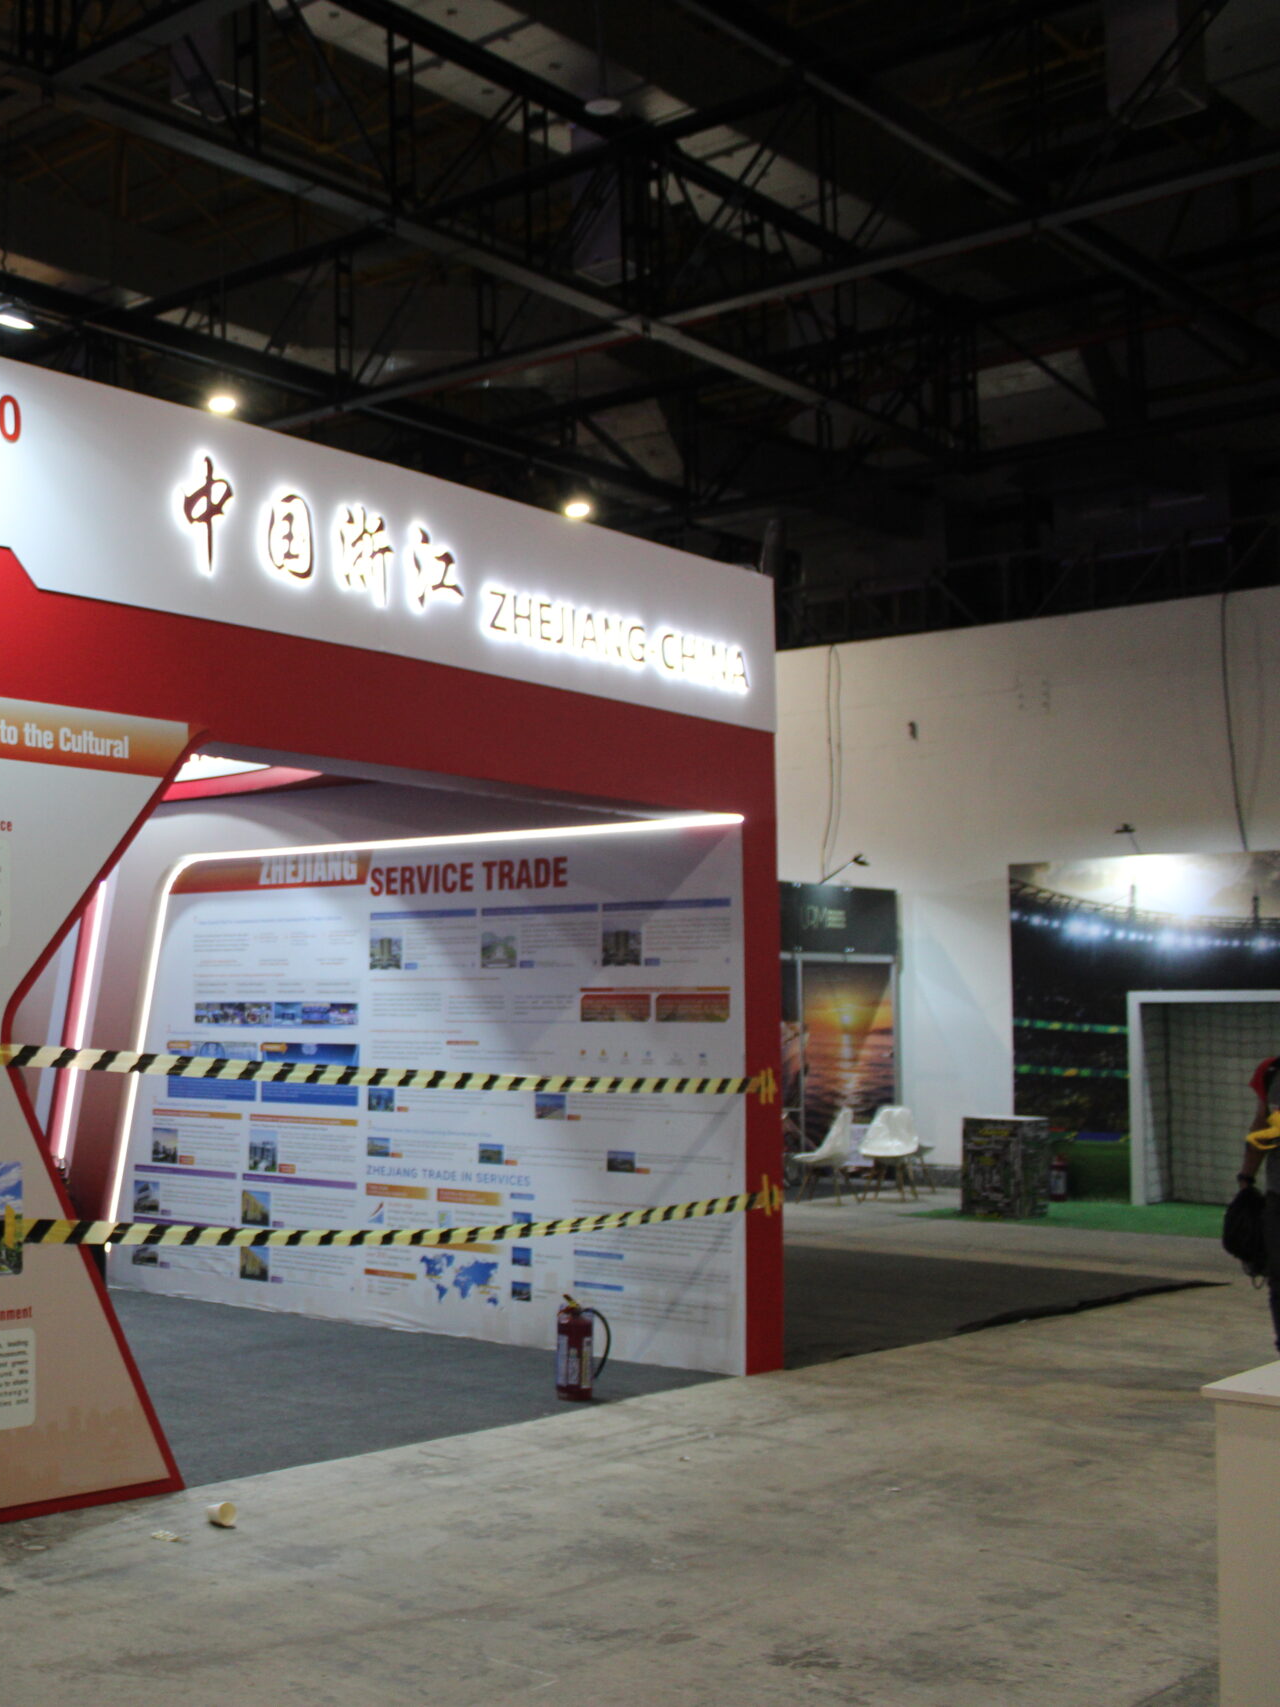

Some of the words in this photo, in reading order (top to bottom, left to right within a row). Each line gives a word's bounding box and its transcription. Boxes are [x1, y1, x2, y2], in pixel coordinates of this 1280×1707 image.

[183, 456, 465, 606] 中国浙江
[488, 589, 647, 662] ZHEJIANG
[661, 632, 750, 689] CHINA
[23, 722, 54, 749] the
[59, 727, 130, 759] Cultural
[259, 852, 358, 886] ZHEJIANG
[370, 862, 474, 897] SERVICE
[482, 856, 568, 891] TRADE
[366, 1164, 418, 1179] ZHEJIANG
[422, 1169, 457, 1182] TRADE
[461, 1171, 472, 1182] IN
[476, 1172, 531, 1188] SERVICES
